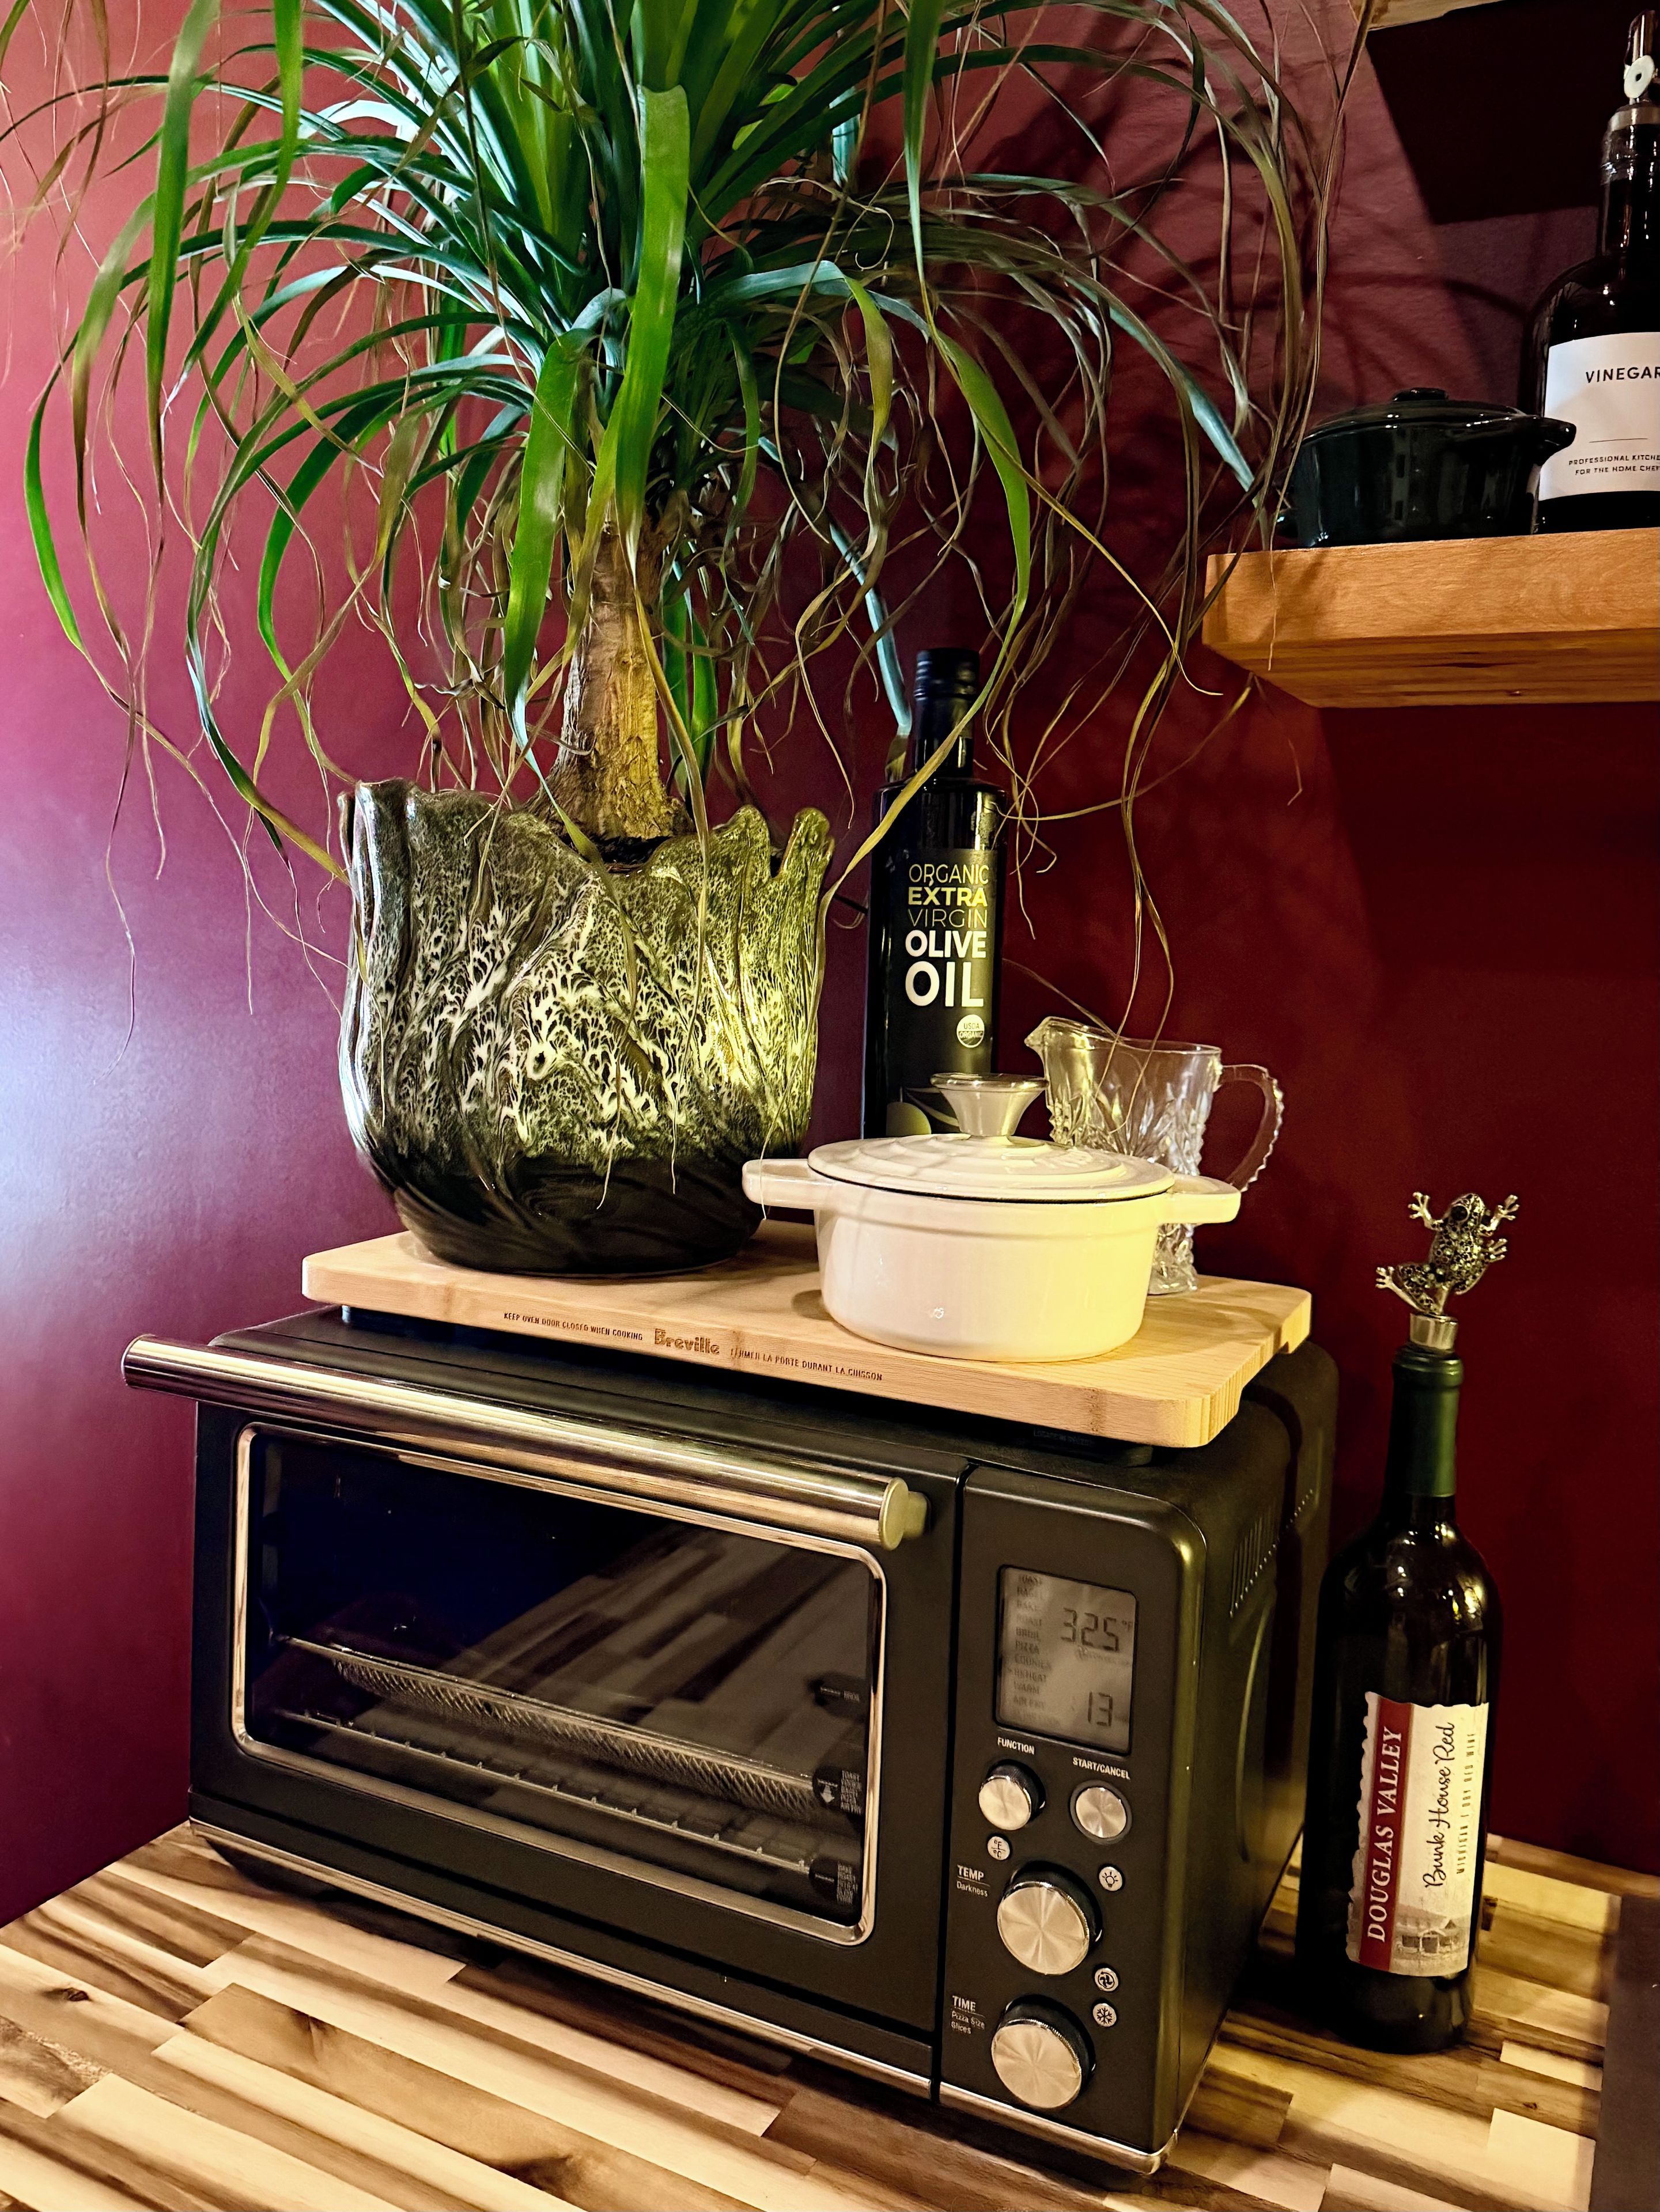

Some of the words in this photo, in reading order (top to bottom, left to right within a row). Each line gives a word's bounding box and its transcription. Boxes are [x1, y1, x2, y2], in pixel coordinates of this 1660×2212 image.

[1568, 456, 1629, 465] PROFESSIONAL
[909, 863, 989, 885] ORGANIC
[908, 887, 988, 907] EXTRA
[908, 908, 988, 929] VIRGIN
[905, 930, 987, 958] OLIVE
[905, 961, 984, 1007] OIL
[959, 1031, 984, 1039] ORGANIC
[504, 1312, 520, 1321] KEEP
[522, 1315, 540, 1324] OVEN
[542, 1318, 560, 1328] DOOR
[562, 1321, 589, 1331] CLOSED
[591, 1325, 610, 1335] WHEN
[612, 1329, 643, 1340] COOKING
[655, 1328, 720, 1355] Breville
[763, 1354, 772, 1362] LA
[775, 1355, 799, 1367] PORTE
[802, 1360, 833, 1372] DURANT
[835, 1366, 846, 1375] LA
[848, 1369, 883, 1381] CUISSON
[1060, 1607, 1120, 1652] 325
[1087, 1691, 1113, 1727] 13
[997, 1737, 1035, 1755] FUNCTION
[1432, 1722, 1455, 1764] Red
[1072, 1757, 1130, 1780] START/CANCEL
[1377, 1726, 1402, 1816] VALLEY
[1428, 1766, 1451, 1828] House
[956, 1864, 985, 1881] TEMP
[1423, 1832, 1447, 1888] Bunk
[956, 1880, 988, 1897] Darkness
[1367, 1825, 1394, 1943] DOUGLAS
[952, 1995, 977, 2012] TIME
[951, 2010, 969, 2024] Pizza
[970, 2017, 985, 2030] Size
[951, 2021, 971, 2034] Slices
